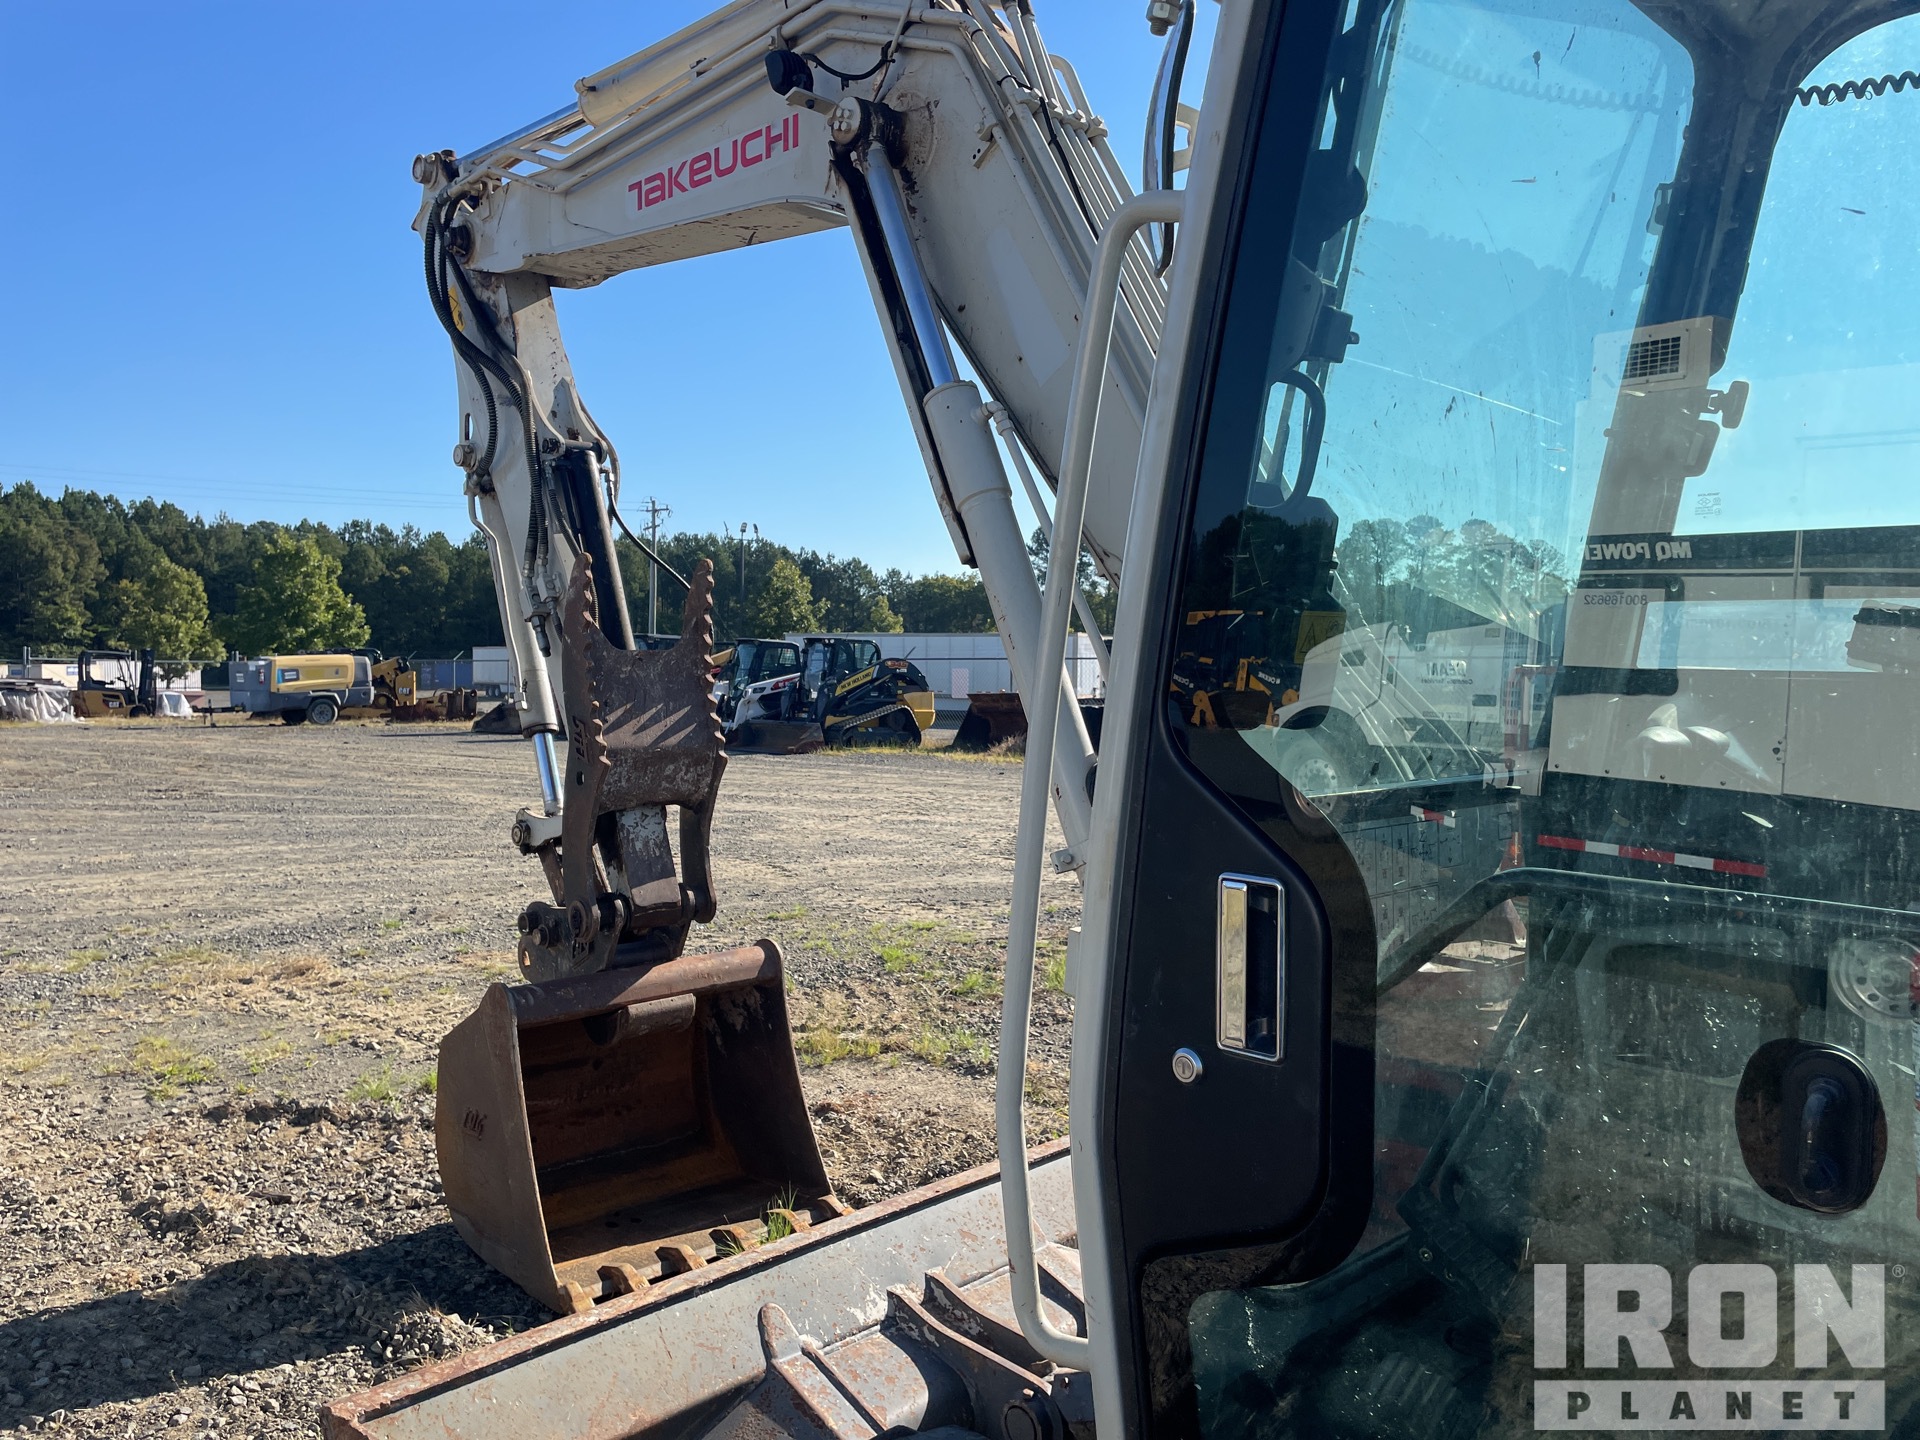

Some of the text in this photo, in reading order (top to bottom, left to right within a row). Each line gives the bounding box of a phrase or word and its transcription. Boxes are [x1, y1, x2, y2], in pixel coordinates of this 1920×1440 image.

[628, 113, 799, 211] TAKEUCHI
[398, 687, 411, 696] CAT
[108, 701, 120, 709] CAT
